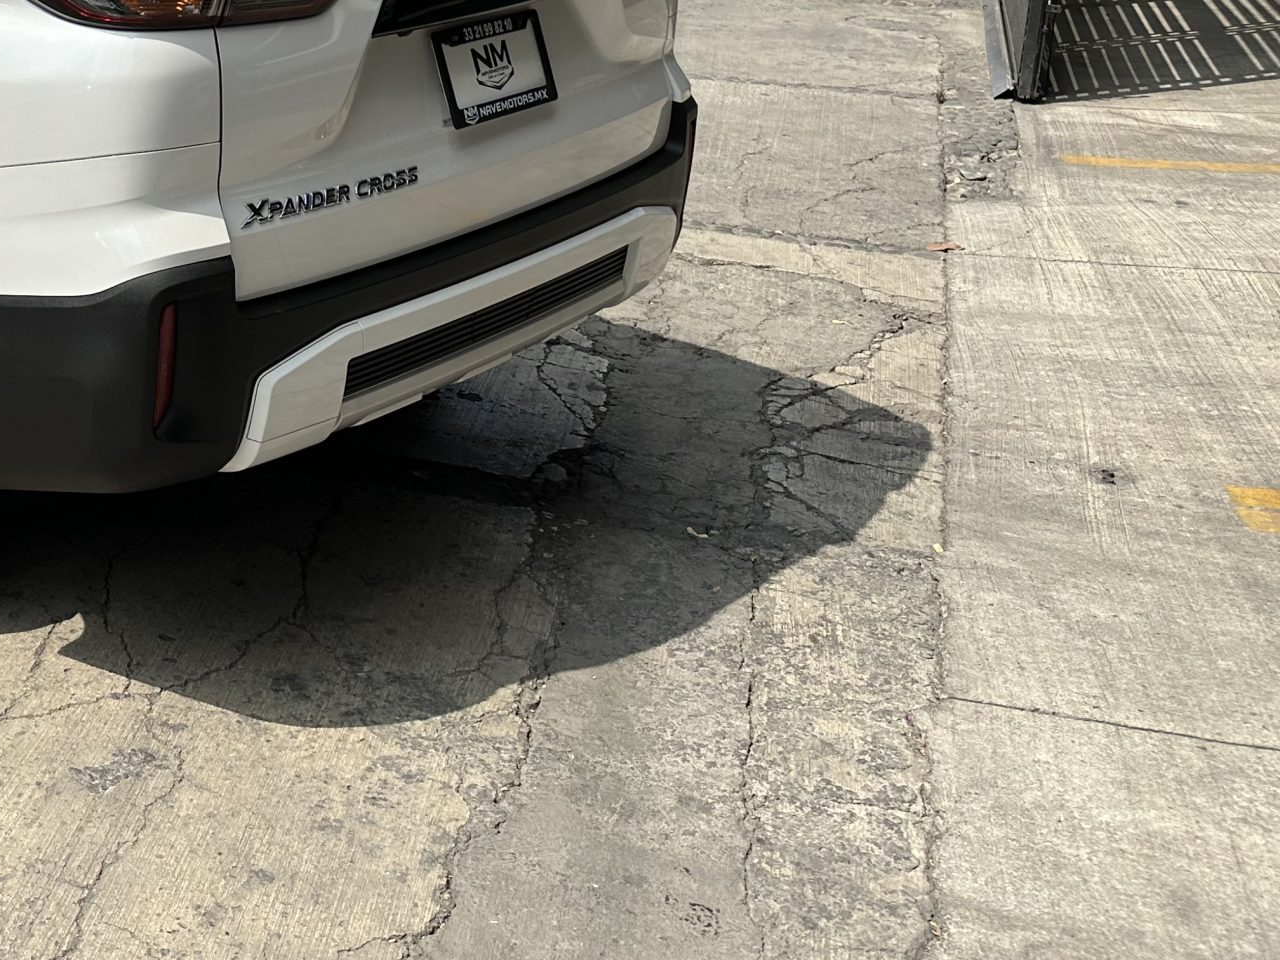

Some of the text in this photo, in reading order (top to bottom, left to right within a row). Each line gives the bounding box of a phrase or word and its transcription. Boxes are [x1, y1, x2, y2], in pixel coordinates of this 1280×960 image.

[463, 27, 474, 41] 33
[483, 22, 494, 37] 99
[494, 19, 504, 34] 82
[470, 39, 512, 77] NM
[240, 165, 419, 229] XPANDER CROSS
